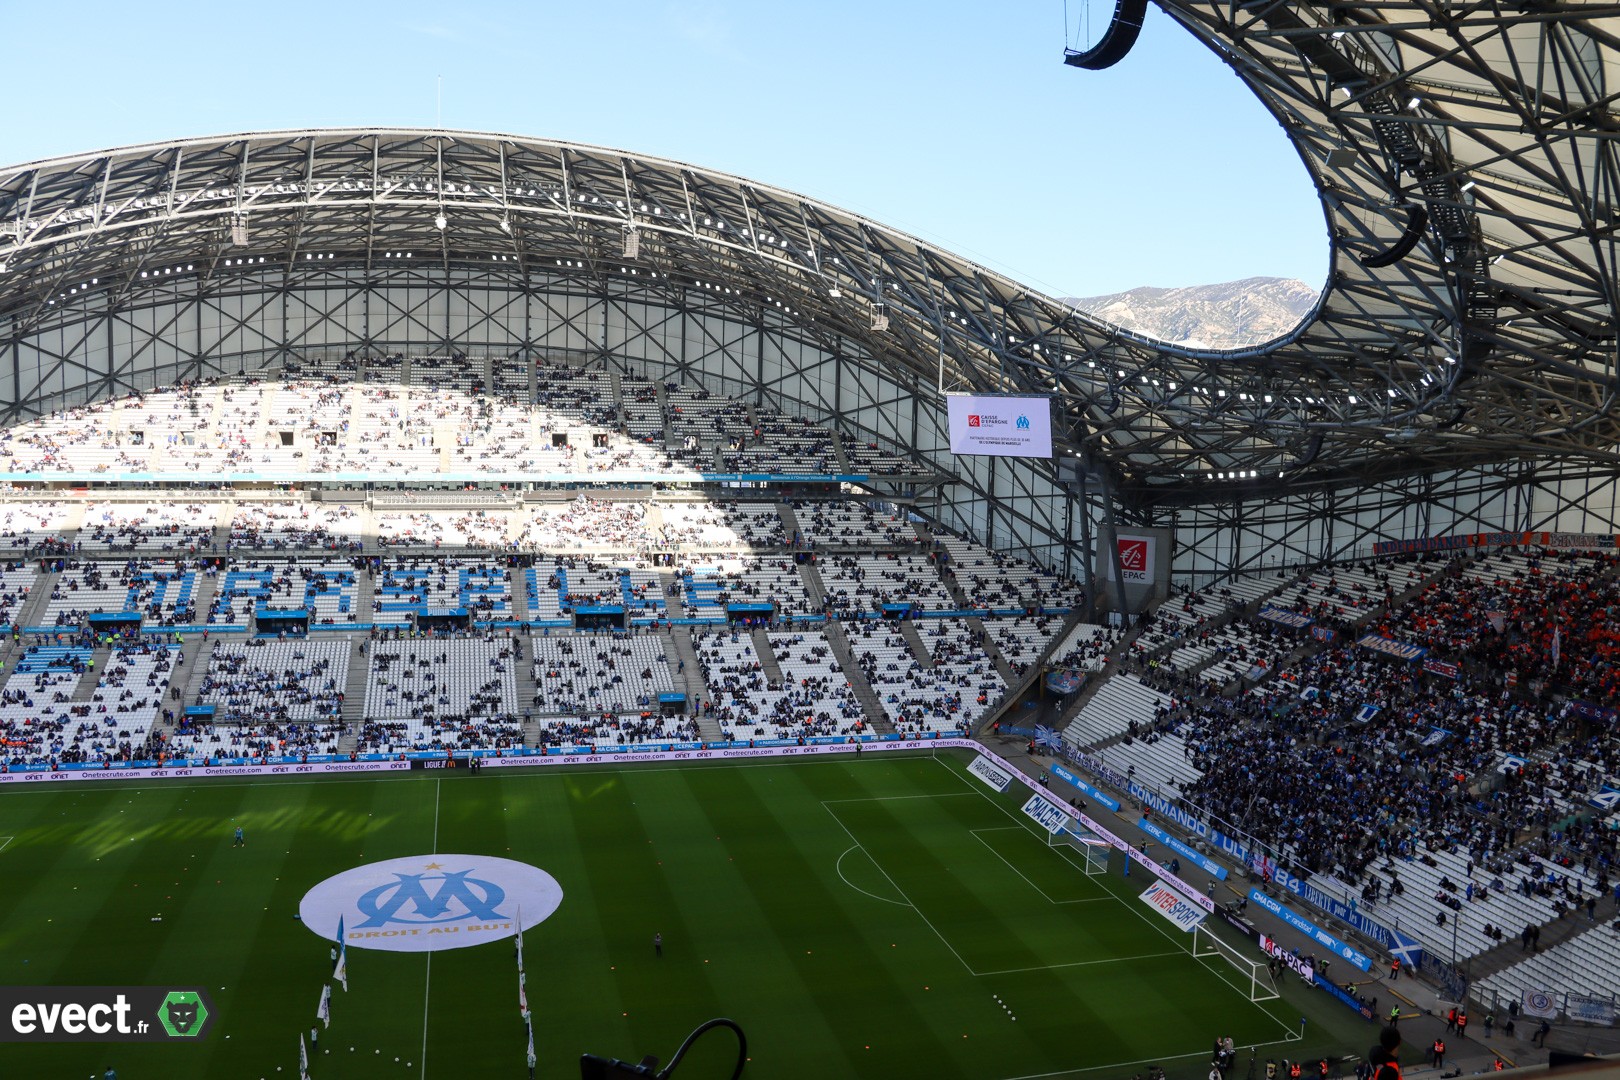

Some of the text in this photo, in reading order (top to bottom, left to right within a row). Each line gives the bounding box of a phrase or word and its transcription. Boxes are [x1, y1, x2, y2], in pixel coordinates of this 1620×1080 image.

[1123, 571, 1146, 580] EPAC
[1130, 784, 1206, 838] COMMANDO
[1275, 867, 1300, 894] 84
[1148, 825, 1162, 837] CEPAC
[1159, 869, 1194, 897] Onetrecrute.com
[1150, 888, 1200, 926] INTERSPORT
[1334, 904, 1347, 916] pour
[1349, 908, 1358, 924] les
[348, 923, 513, 940] DROIT AU BUT
[1292, 917, 1313, 933] randstad
